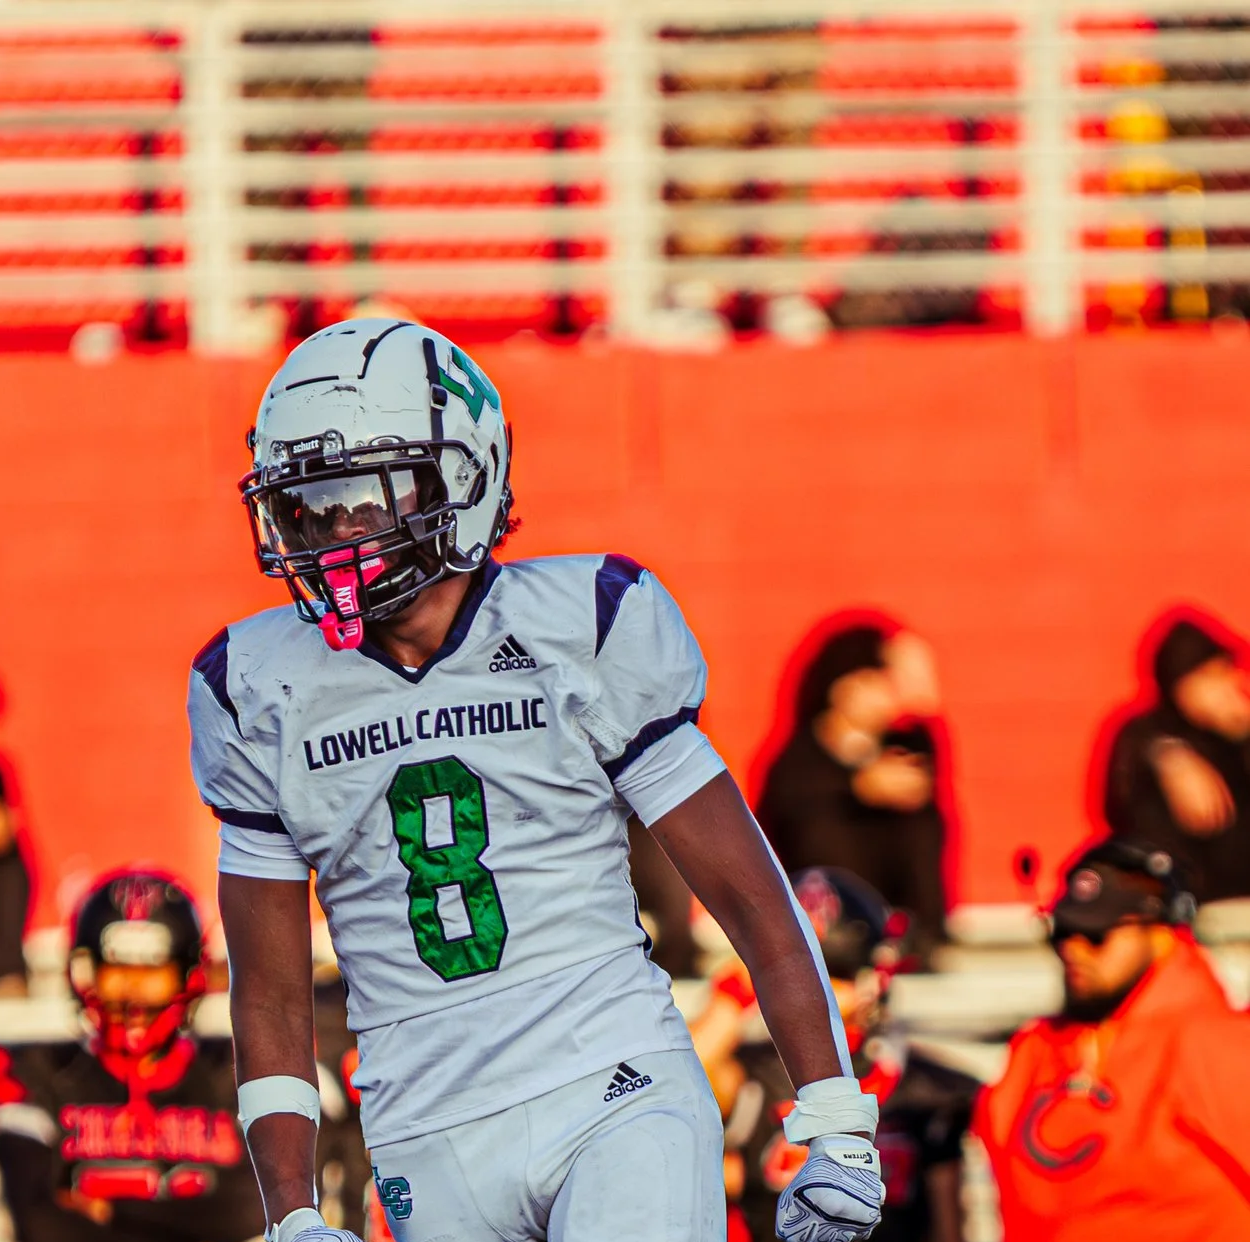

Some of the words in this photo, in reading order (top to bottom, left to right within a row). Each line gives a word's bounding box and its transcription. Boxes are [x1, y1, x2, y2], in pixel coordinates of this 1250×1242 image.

[292, 438, 320, 454] schutt
[335, 586, 359, 637] NXTND
[488, 655, 538, 673] adidas
[303, 715, 413, 771] LOWELL
[415, 696, 548, 740] CATHOLIC
[385, 754, 510, 984] 8
[602, 1073, 654, 1103] adidas
[842, 1151, 874, 1165] CUTTERS
